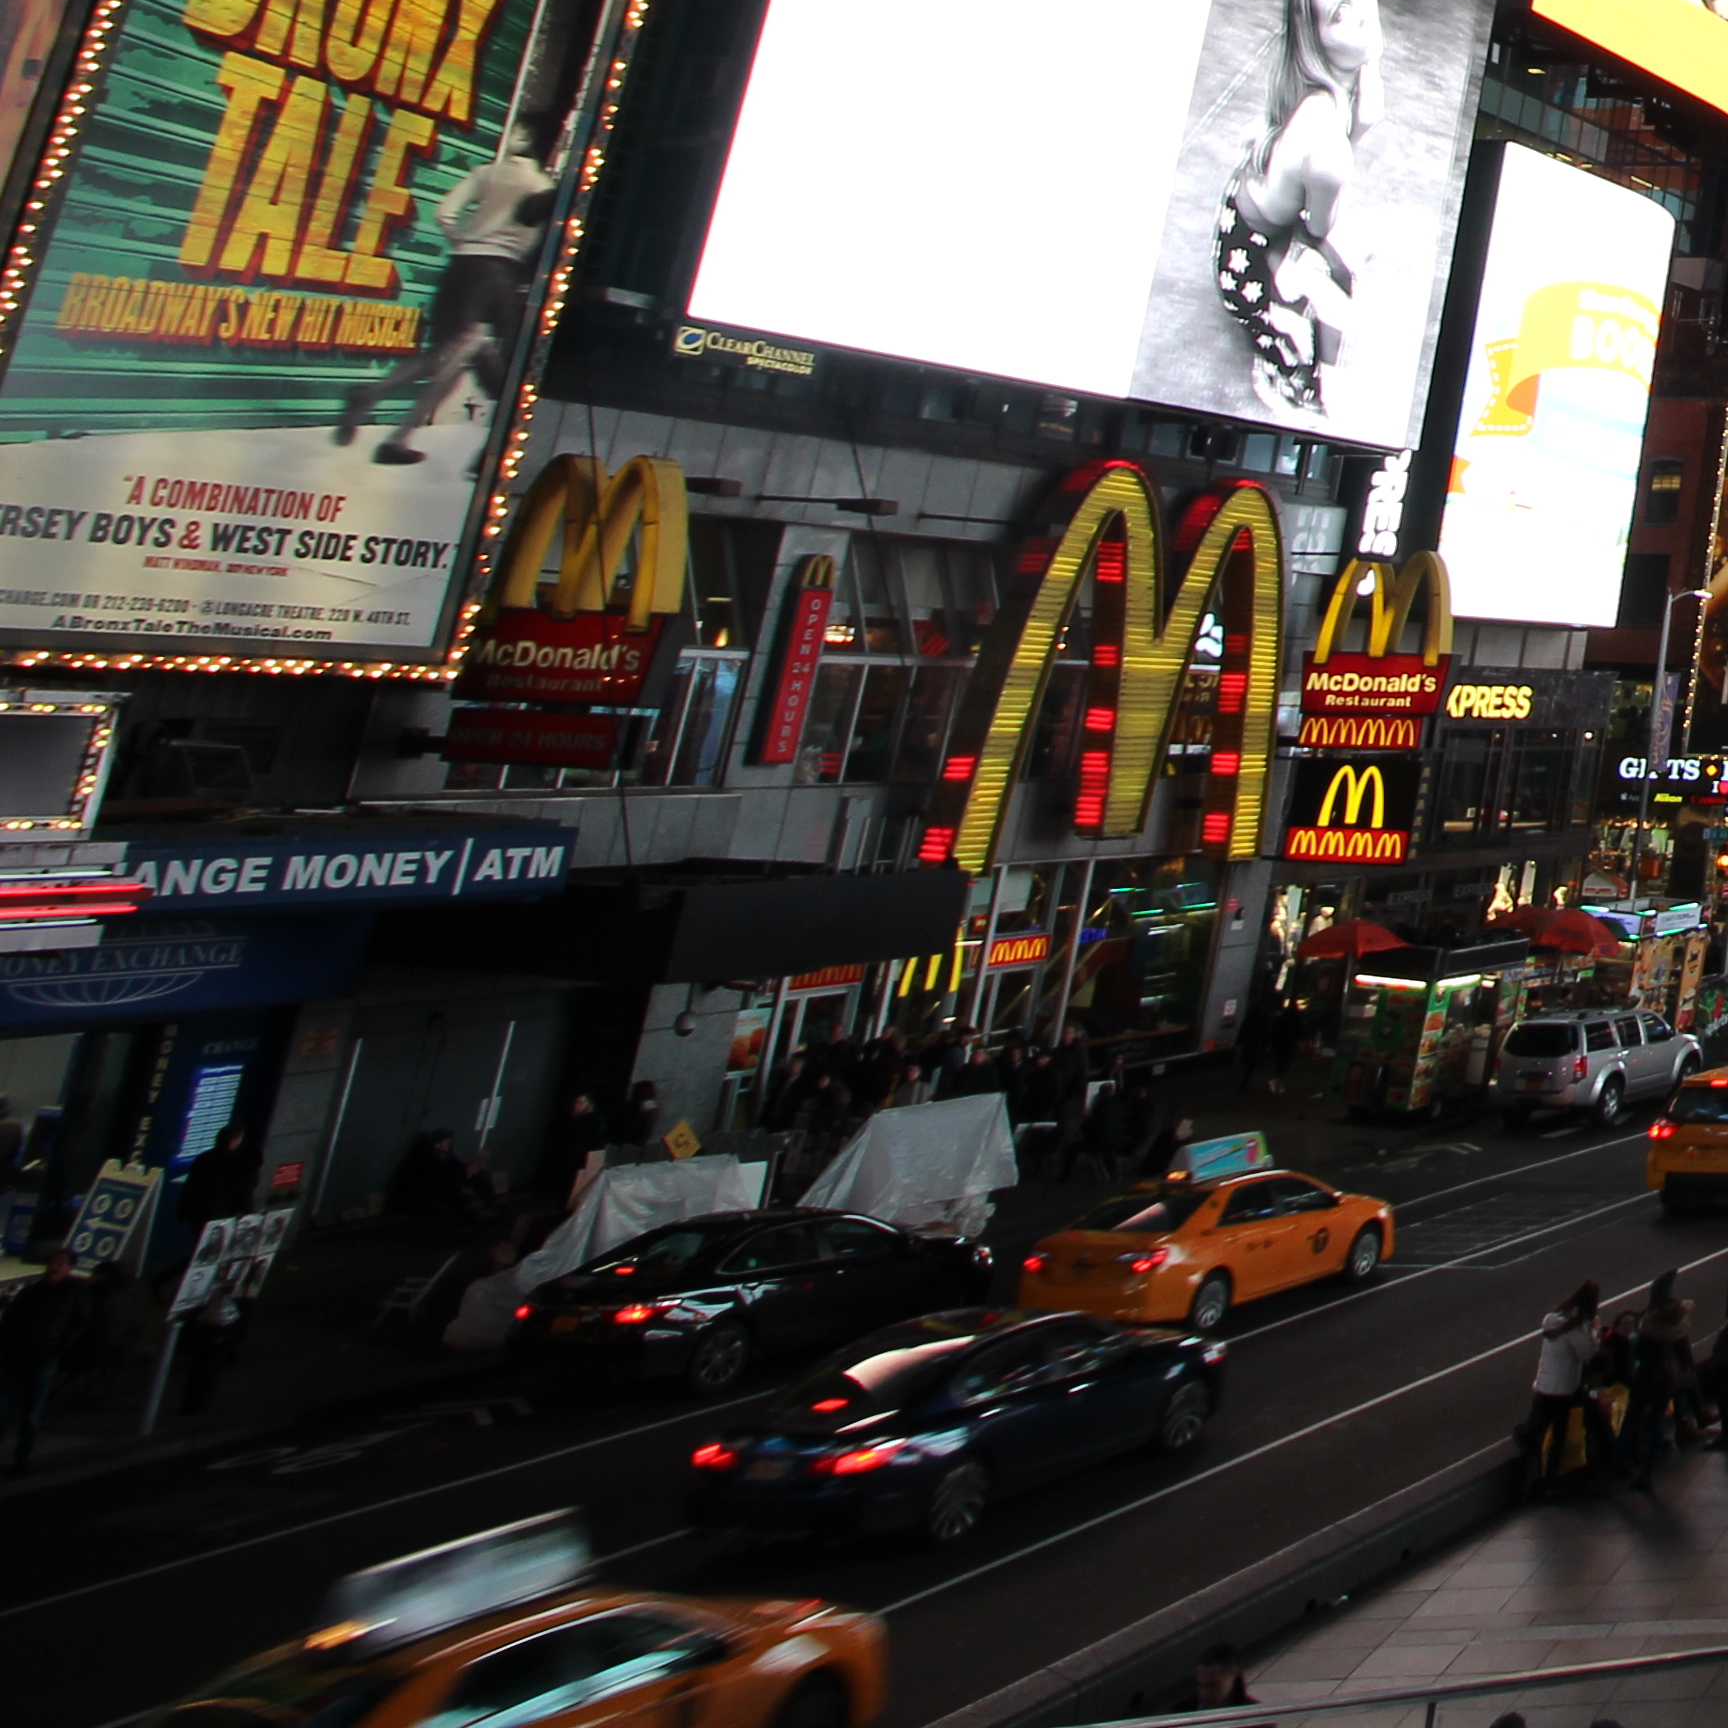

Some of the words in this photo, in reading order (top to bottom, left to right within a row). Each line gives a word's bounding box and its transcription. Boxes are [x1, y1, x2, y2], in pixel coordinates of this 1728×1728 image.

[179, 50, 438, 290] TALE
[57, 272, 249, 345] BROADWAY'S
[242, 285, 301, 346] NEW
[301, 294, 337, 348] HIT
[338, 299, 421, 352] MUSICAL
[149, 479, 312, 522] COMBINATION
[316, 494, 347, 524] OF
[0, 503, 88, 541] RSEY
[90, 512, 176, 549] BOYS
[178, 520, 201, 550] &
[211, 521, 295, 559] WEST
[294, 529, 353, 562] SIDE
[50, 614, 333, 640] ABronxTaleTheMusical.com
[801, 599, 821, 655] OPEN
[474, 638, 641, 671] McDonald's
[1306, 672, 1438, 693] McDonald's
[1325, 694, 1412, 708] Restaurant
[777, 680, 803, 753] HOURS
[1619, 757, 1702, 781] GITS
[281, 849, 454, 892] MONEY
[472, 845, 565, 881] ATM
